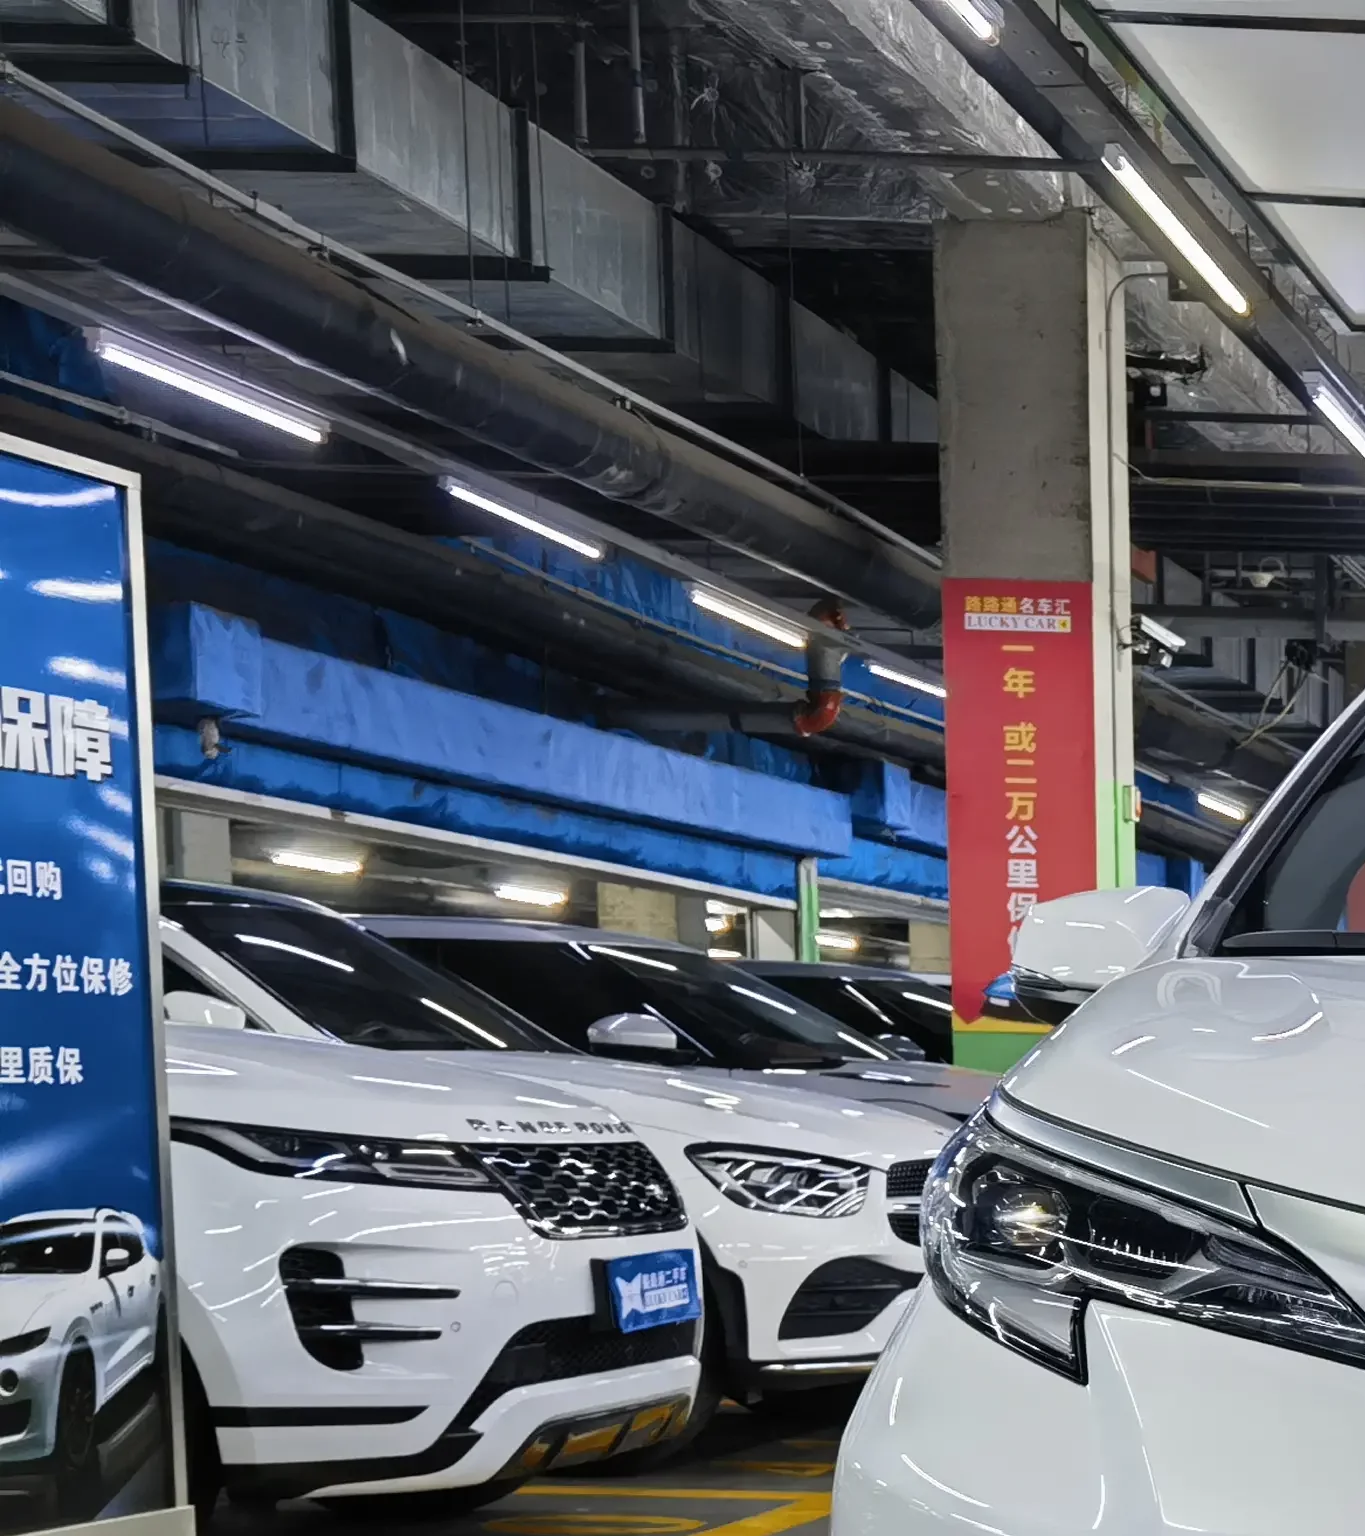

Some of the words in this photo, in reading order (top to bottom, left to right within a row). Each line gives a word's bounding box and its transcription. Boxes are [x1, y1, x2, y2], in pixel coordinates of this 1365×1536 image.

[967, 615, 1020, 629] LUCKY
[1024, 617, 1057, 630] CAR
[0, 950, 134, 996] 全方位保修
[0, 1045, 84, 1086] 里质保
[466, 1118, 572, 1134] RANGE
